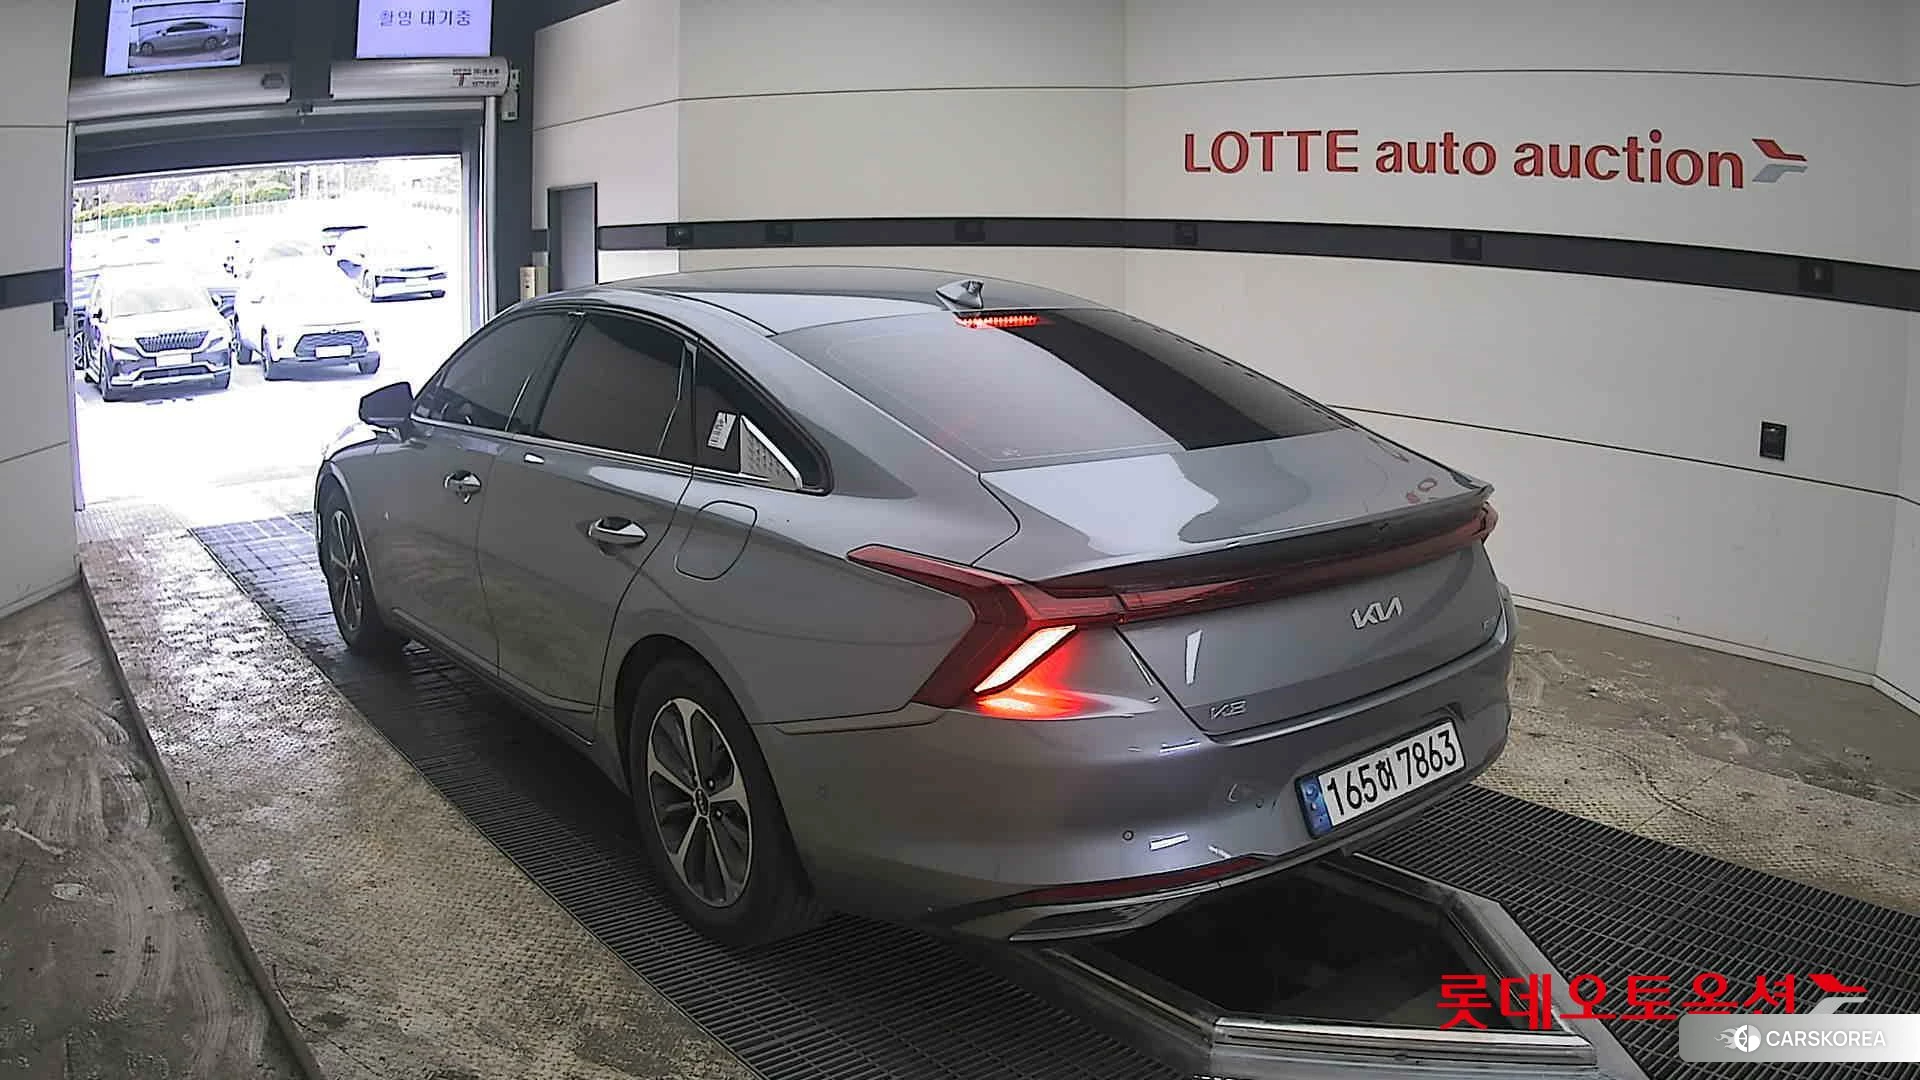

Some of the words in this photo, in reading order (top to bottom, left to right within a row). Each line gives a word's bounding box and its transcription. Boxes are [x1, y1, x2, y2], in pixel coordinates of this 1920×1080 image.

[420, 9, 472, 27] 대기중
[1183, 130, 1359, 173] LOTTE
[1375, 131, 1497, 176] auto
[1514, 128, 1744, 189] auction
[1326, 756, 1398, 817] 165허
[1396, 729, 1457, 785] 7863
